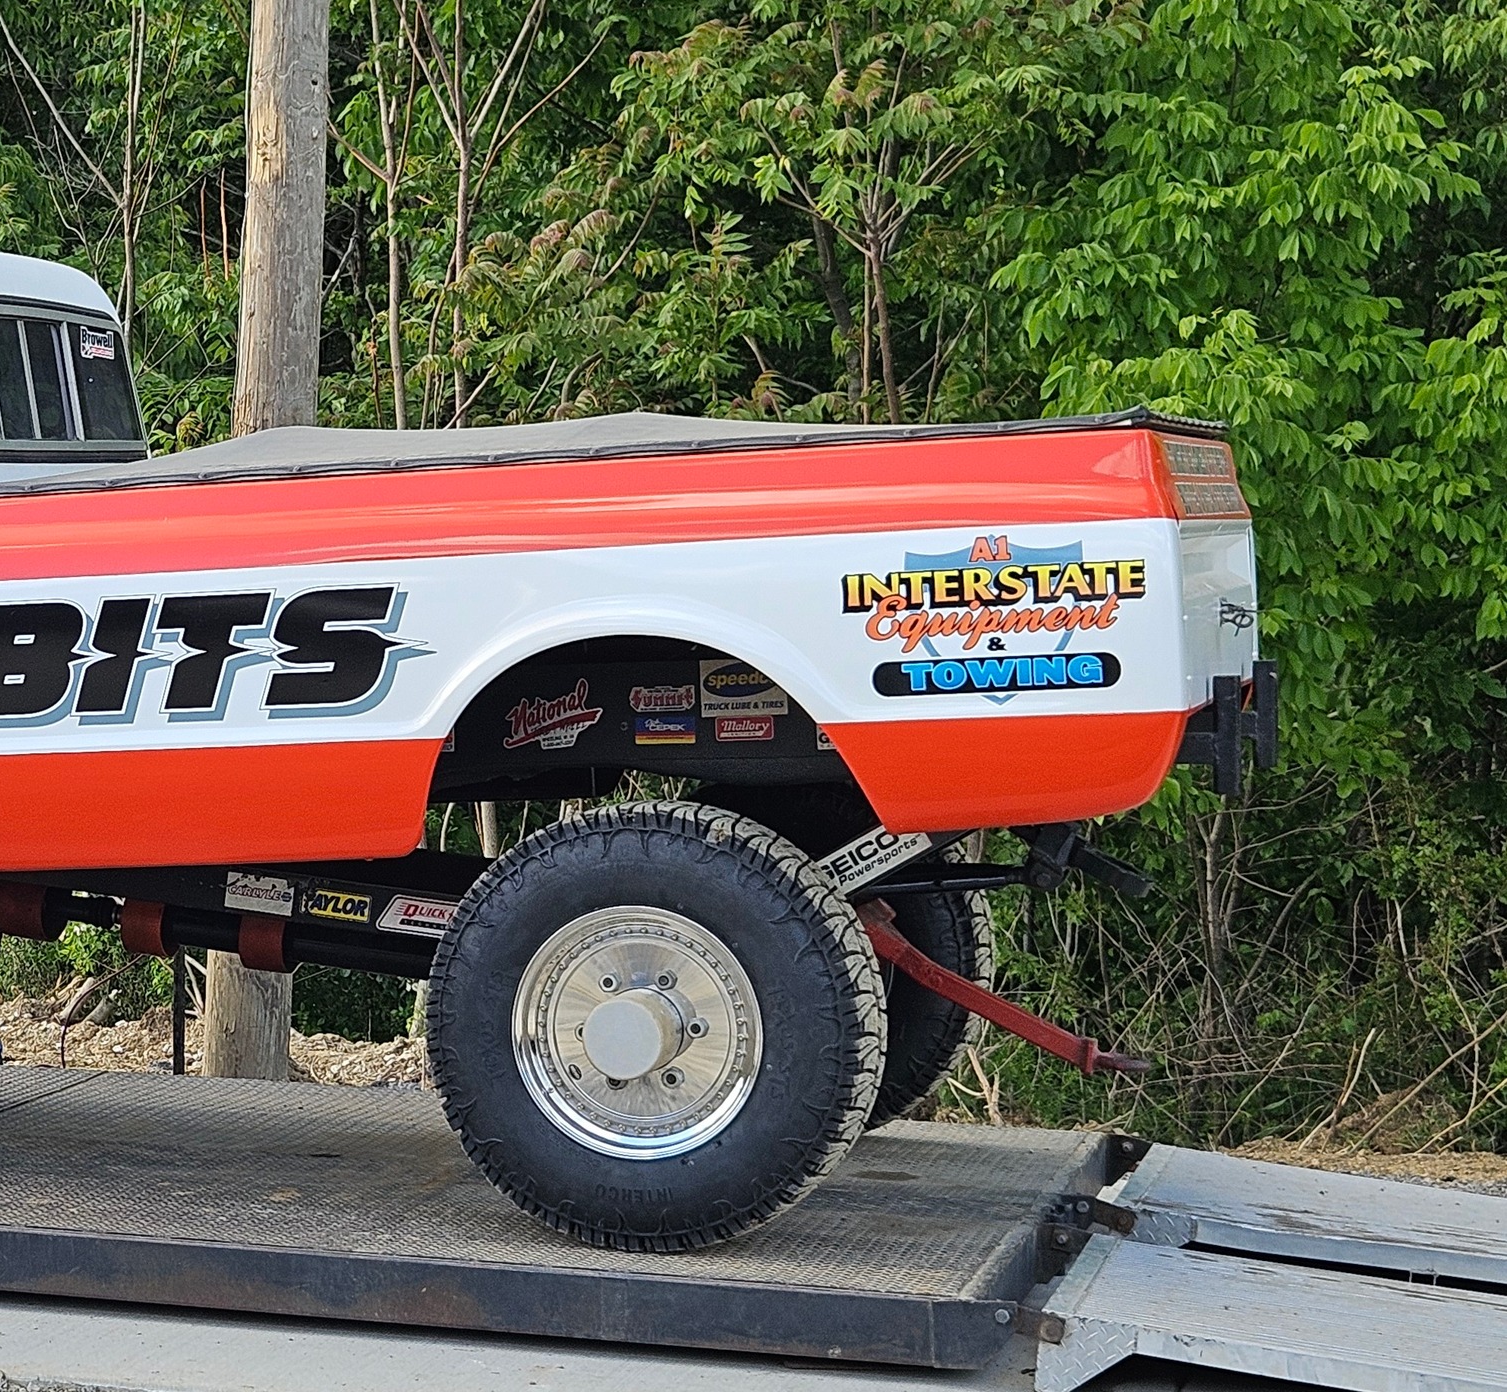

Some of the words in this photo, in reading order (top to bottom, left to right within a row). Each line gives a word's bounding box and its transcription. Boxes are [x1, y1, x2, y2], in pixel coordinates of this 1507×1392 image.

[969, 535, 1012, 563] A1
[842, 559, 1147, 614] INTERSTATE
[865, 594, 1119, 654] Equipment
[986, 636, 1008, 652] &
[902, 655, 1104, 692] TOWING
[505, 678, 588, 737] National
[703, 702, 730, 711] TRUCK
[731, 701, 751, 710] LUBE
[752, 701, 760, 709] &
[761, 700, 784, 709] TIRES
[721, 720, 770, 732] Mallory
[838, 837, 918, 887] Powersports
[228, 885, 282, 901] CARLYLE
